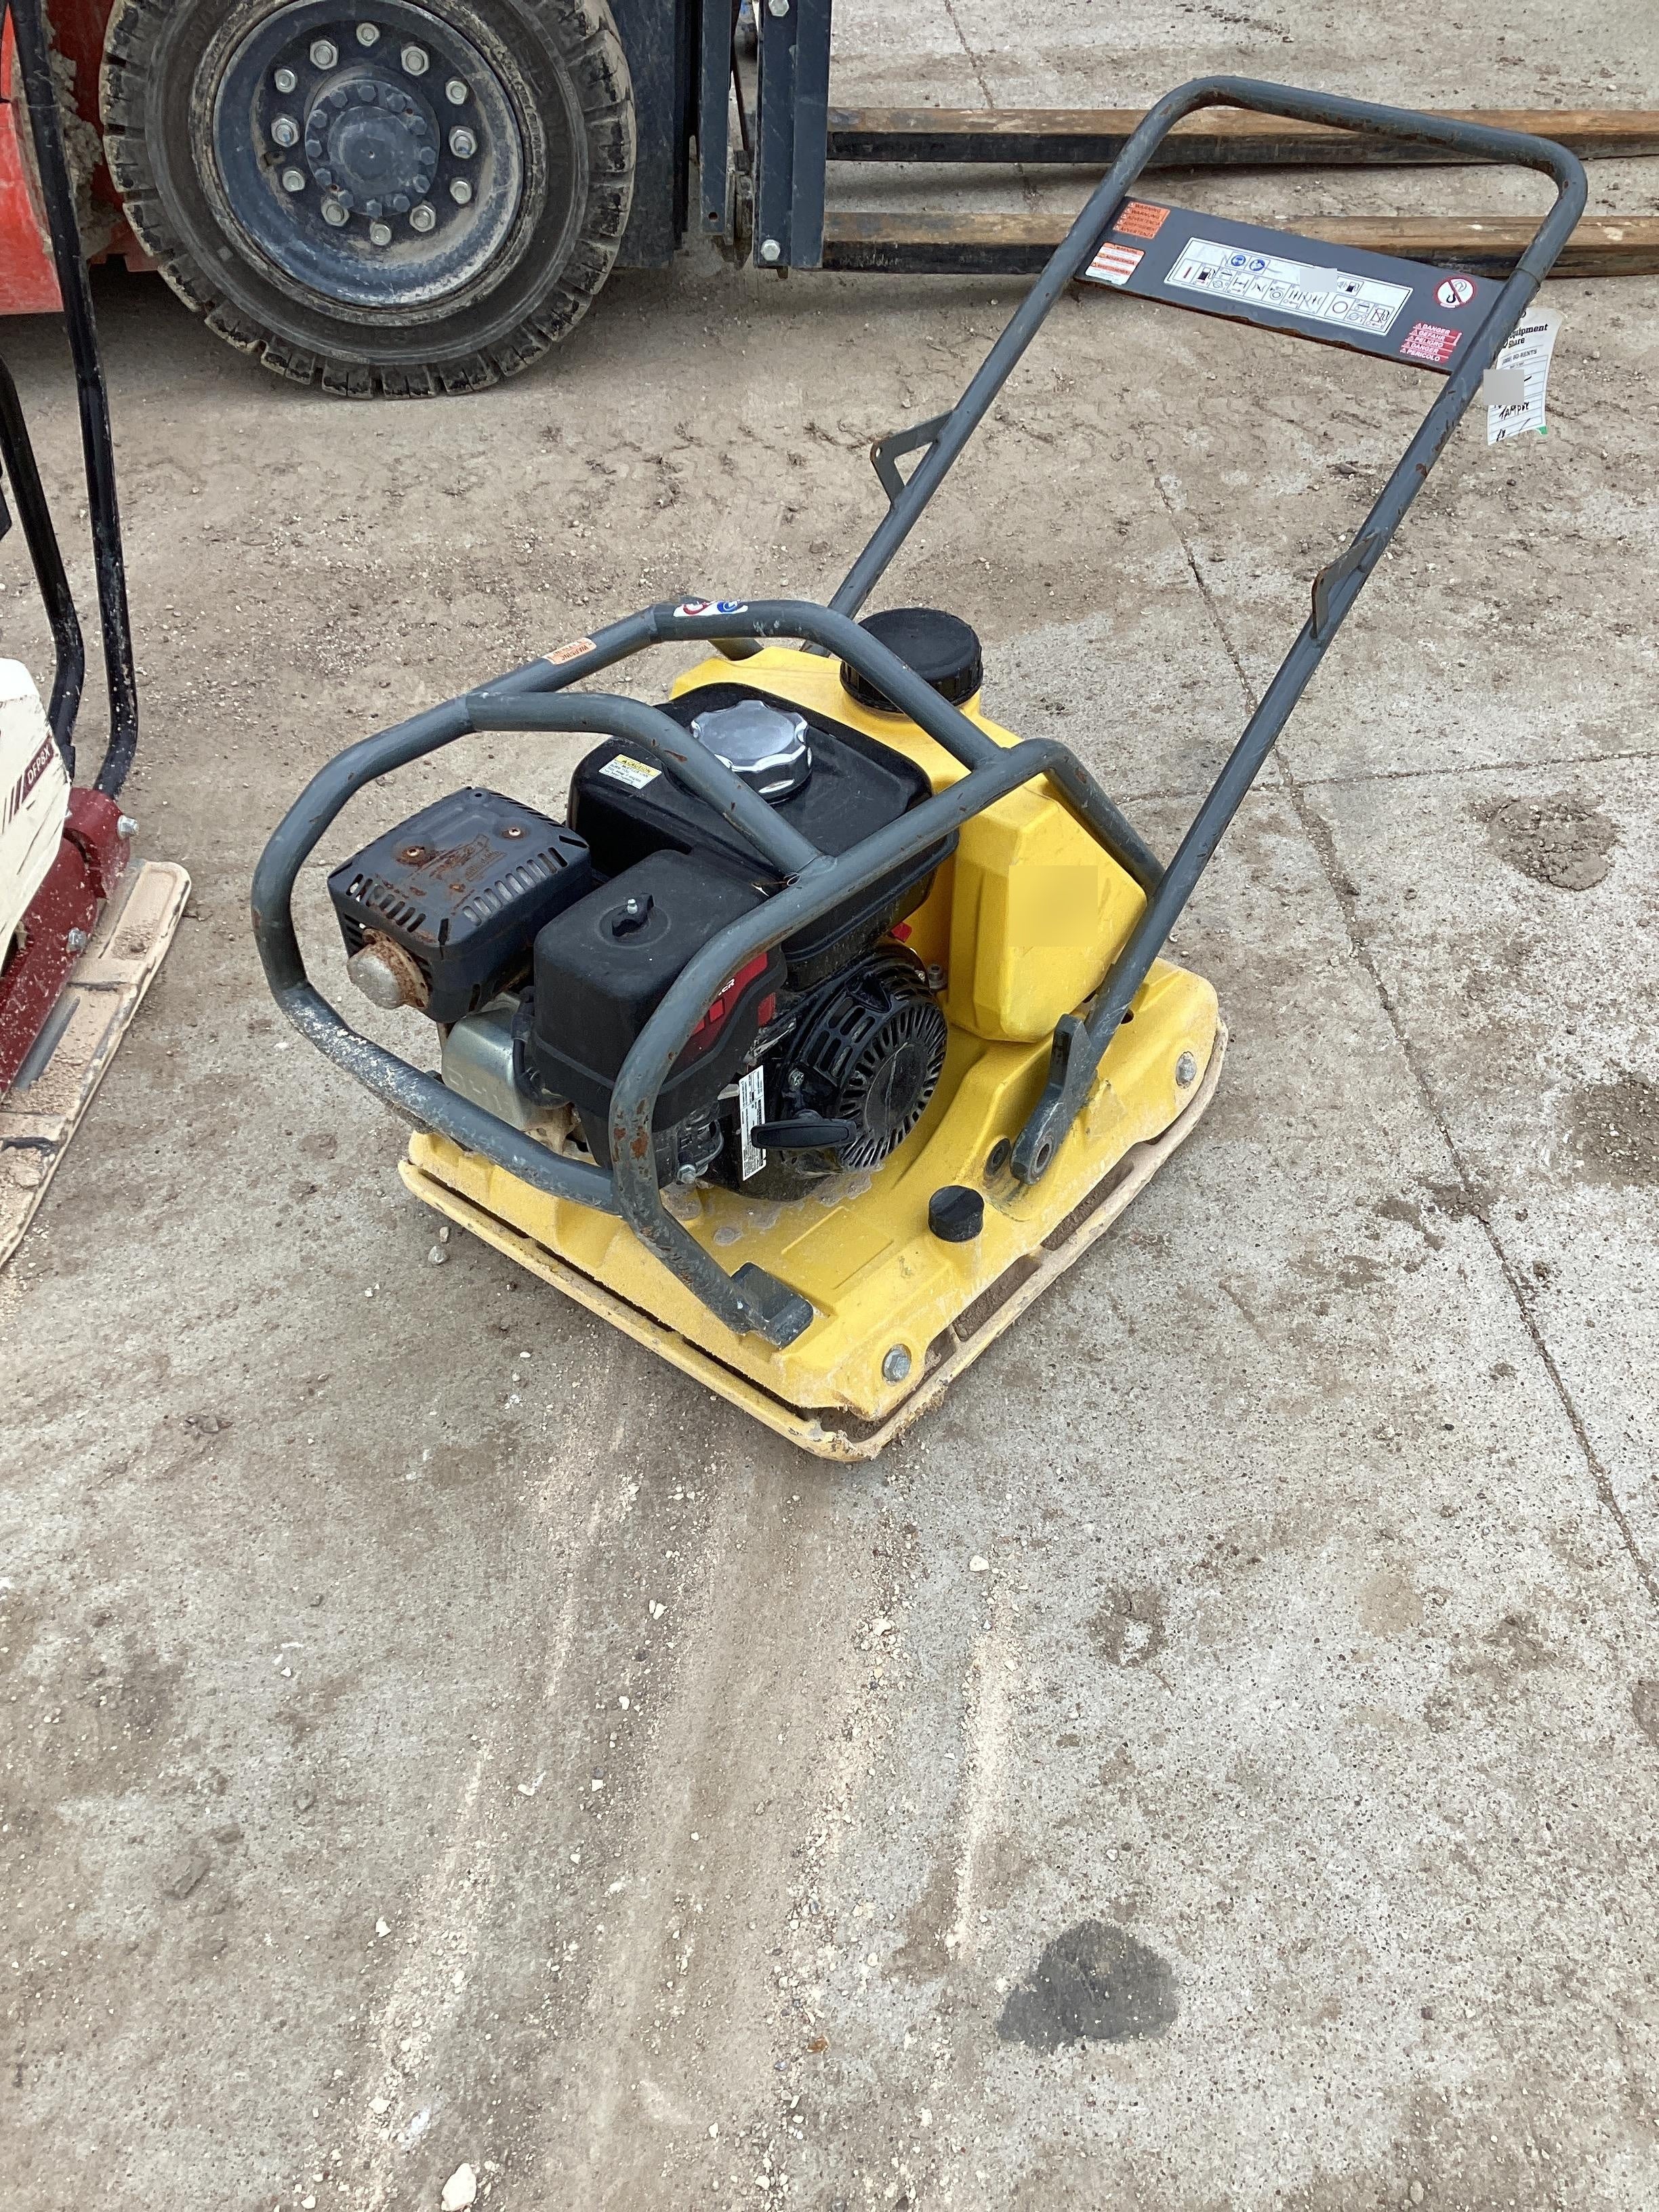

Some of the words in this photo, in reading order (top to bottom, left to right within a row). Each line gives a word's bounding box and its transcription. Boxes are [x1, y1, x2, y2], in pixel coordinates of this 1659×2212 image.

[1422, 324, 1450, 335] DANGER
[1414, 336, 1443, 347] PELIGRO
[1418, 330, 1446, 342] GEFAHR
[1410, 343, 1439, 354] DANGER
[1406, 350, 1441, 361] PERICOLO
[28, 744, 51, 784] DFP8X
[628, 760, 651, 773] CAUTION
